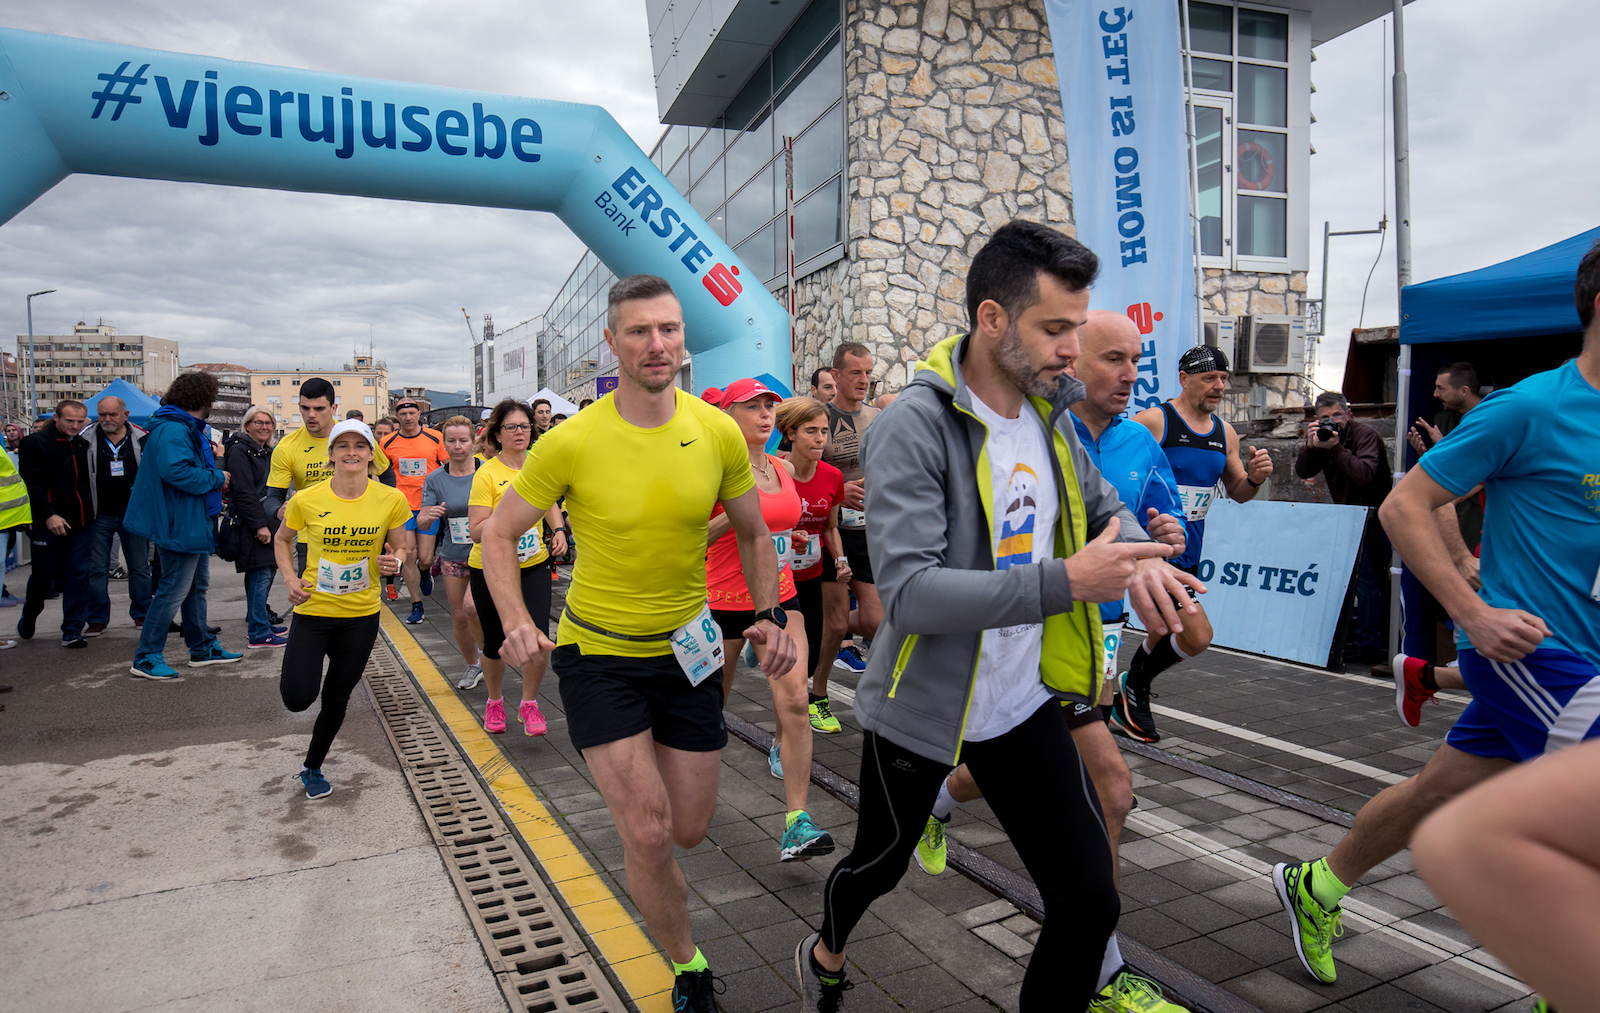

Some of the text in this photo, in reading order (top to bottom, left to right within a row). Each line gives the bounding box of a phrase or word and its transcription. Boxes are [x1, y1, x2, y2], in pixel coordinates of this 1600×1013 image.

[91, 61, 543, 163] #vjerujusebe
[594, 190, 637, 237] Bank
[612, 166, 714, 274] ERSTE
[832, 434, 858, 445] Reebok
[414, 462, 420, 470] 5
[1194, 492, 1211, 507] 72
[323, 525, 380, 537] not your
[323, 537, 341, 547] PB
[518, 534, 535, 550] 32
[772, 536, 786, 555] 0
[340, 567, 363, 582] 43
[1220, 562, 1252, 588] SI
[1258, 563, 1319, 597] TEĆ
[701, 611, 717, 644] 8
